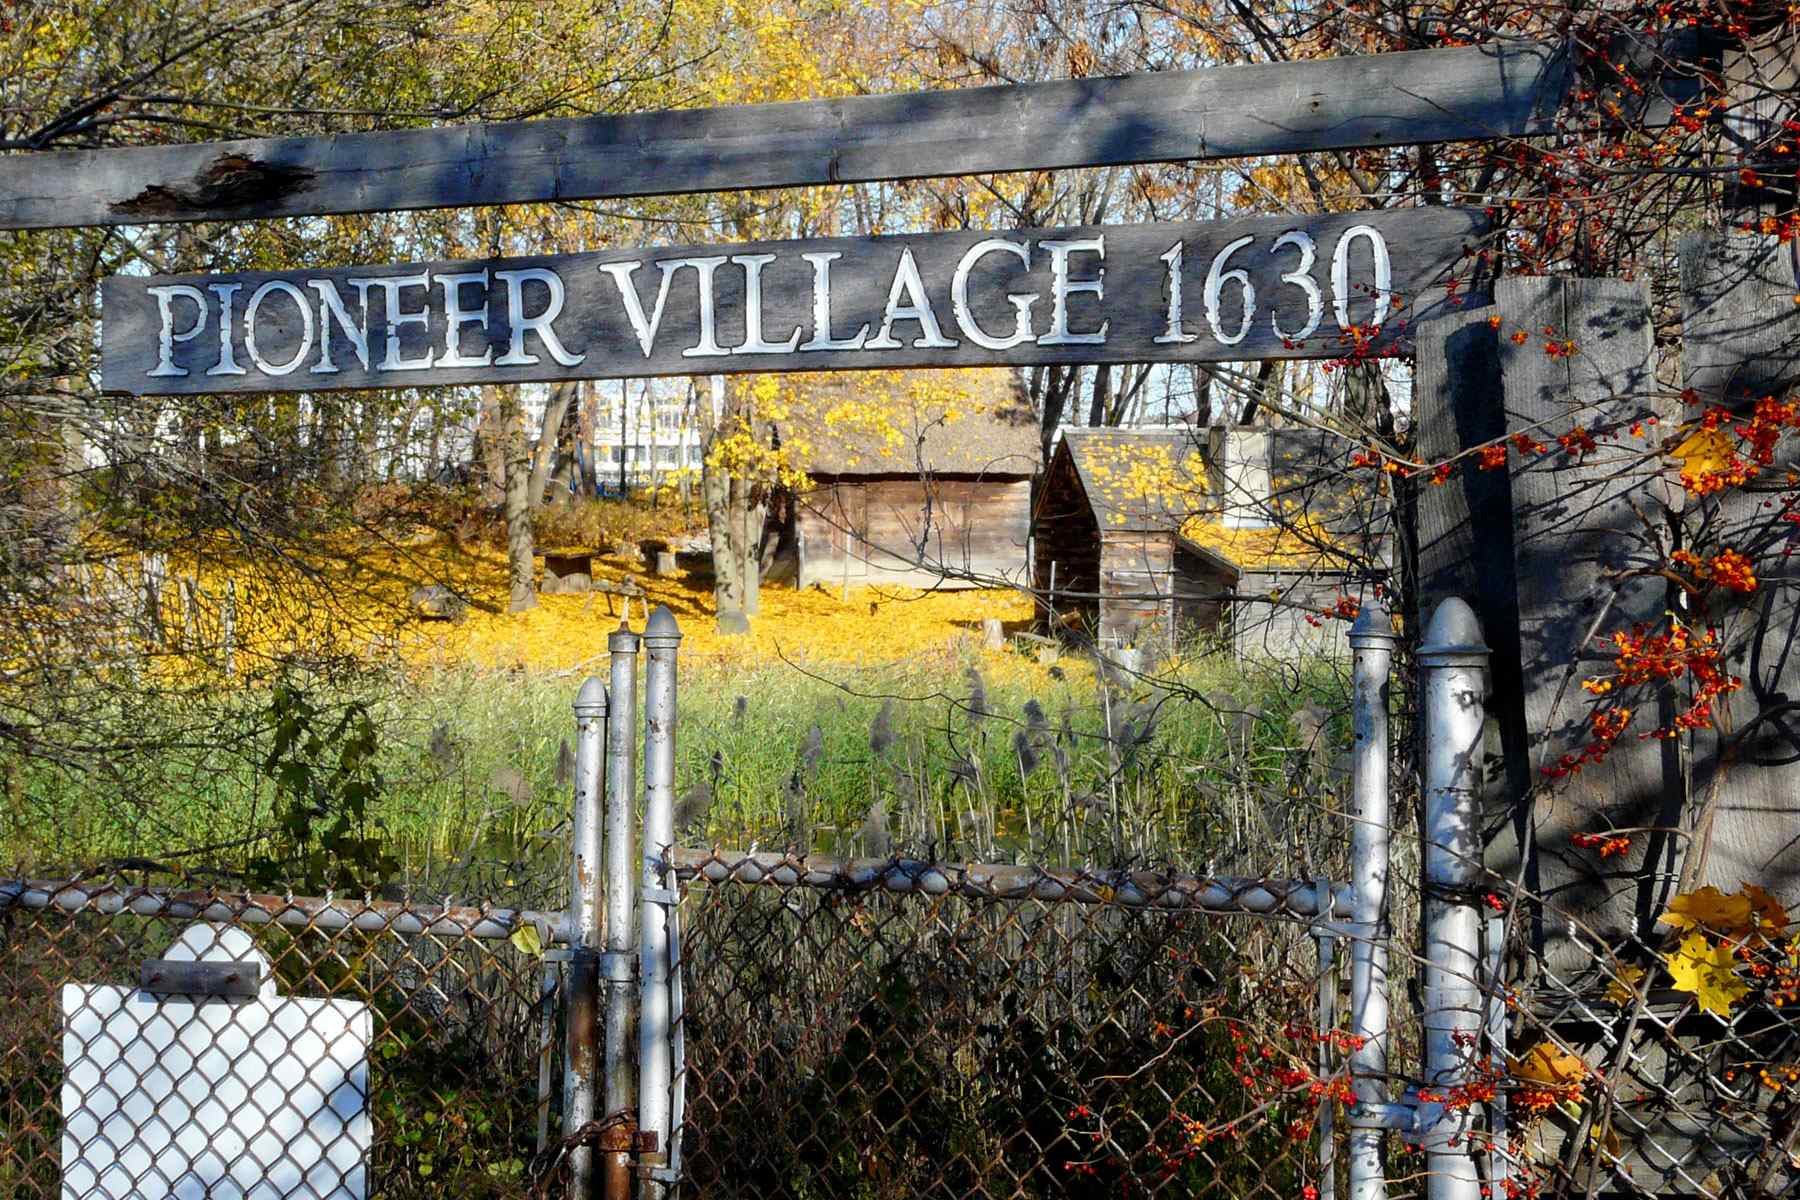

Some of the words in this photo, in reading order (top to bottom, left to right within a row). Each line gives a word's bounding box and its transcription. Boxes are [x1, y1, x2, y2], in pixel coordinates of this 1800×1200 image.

[147, 266, 586, 378] PIONEER
[599, 234, 1109, 359] VILLAGE
[1153, 225, 1392, 346] 1630
